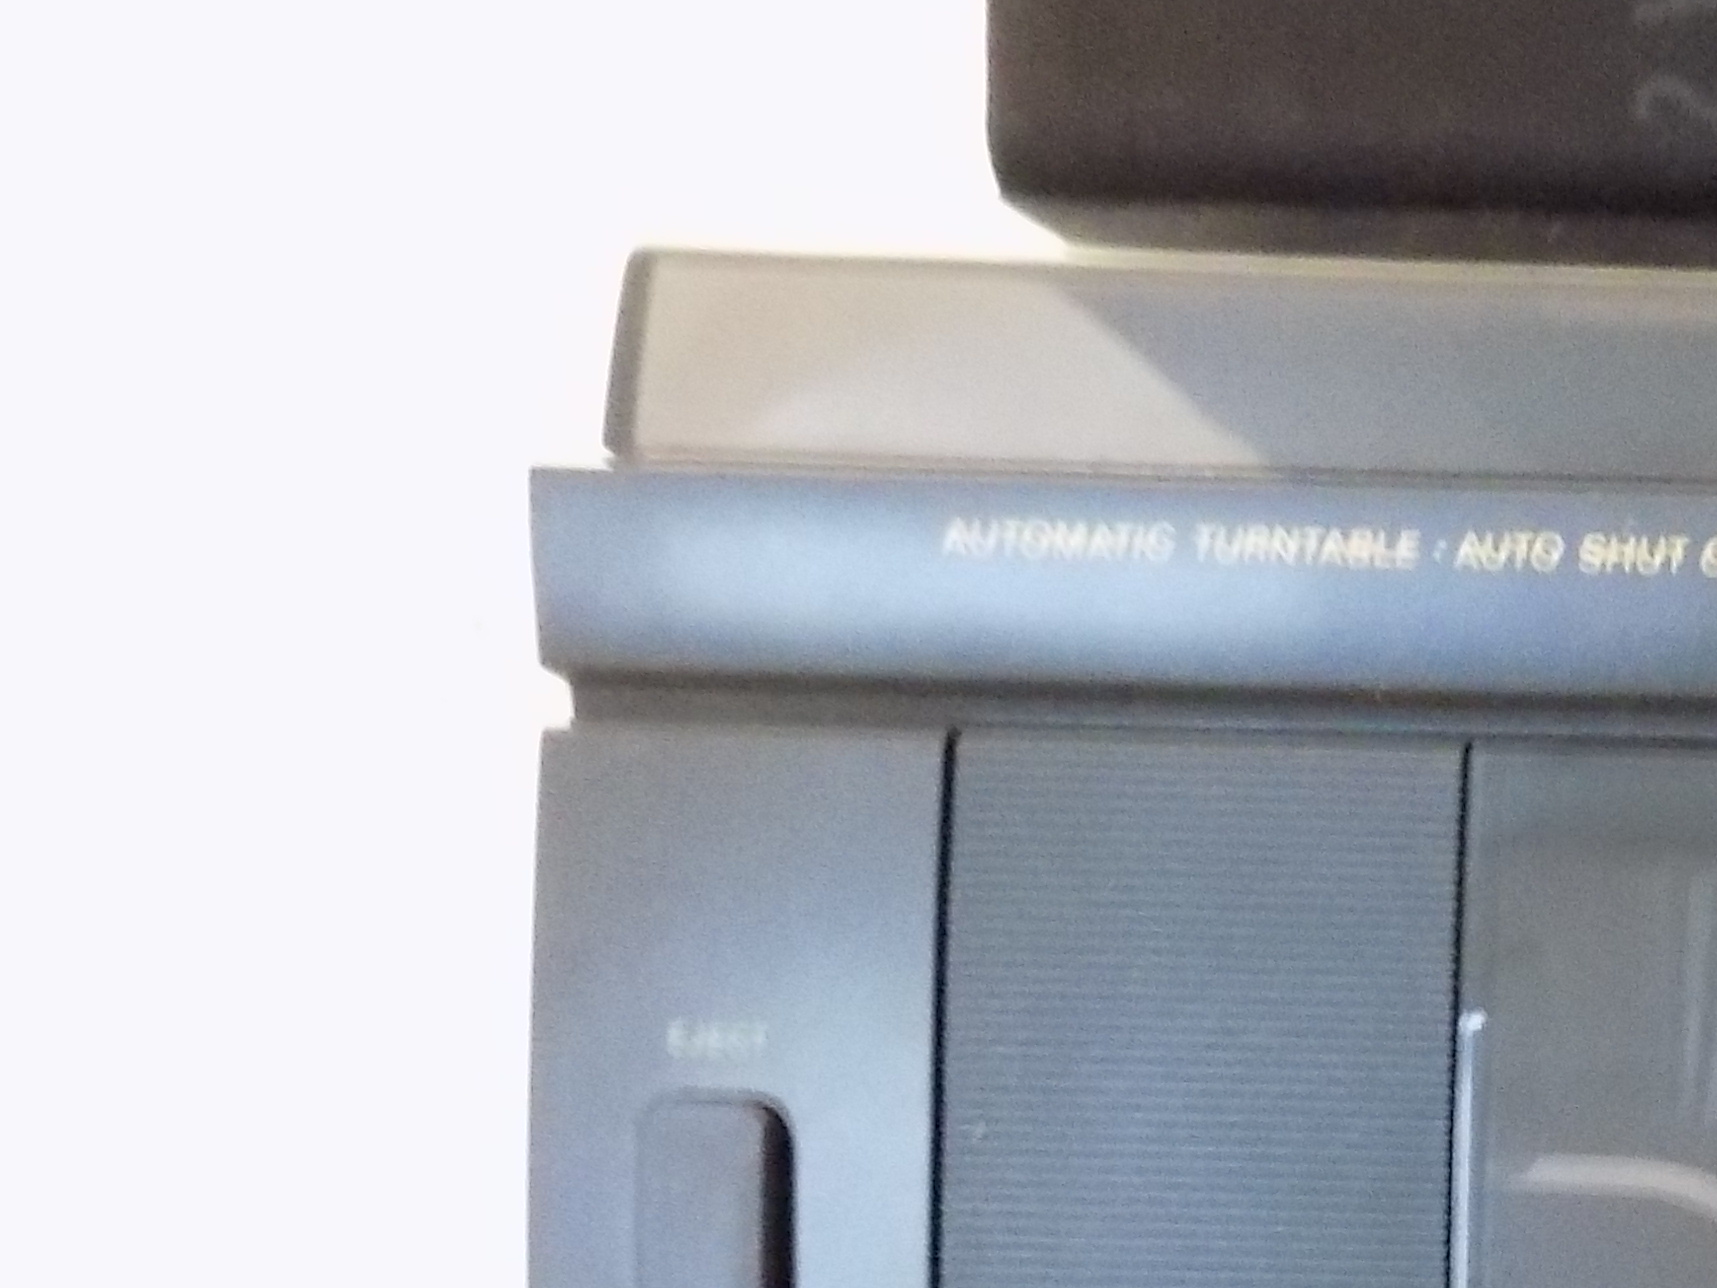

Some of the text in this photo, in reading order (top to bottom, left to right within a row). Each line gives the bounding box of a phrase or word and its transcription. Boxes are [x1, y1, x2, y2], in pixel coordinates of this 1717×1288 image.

[943, 518, 1176, 563] AUTOMATIC
[1197, 524, 1420, 569] TURNTABLE
[1454, 531, 1565, 573] AUTO
[1577, 533, 1689, 577] SHUT
